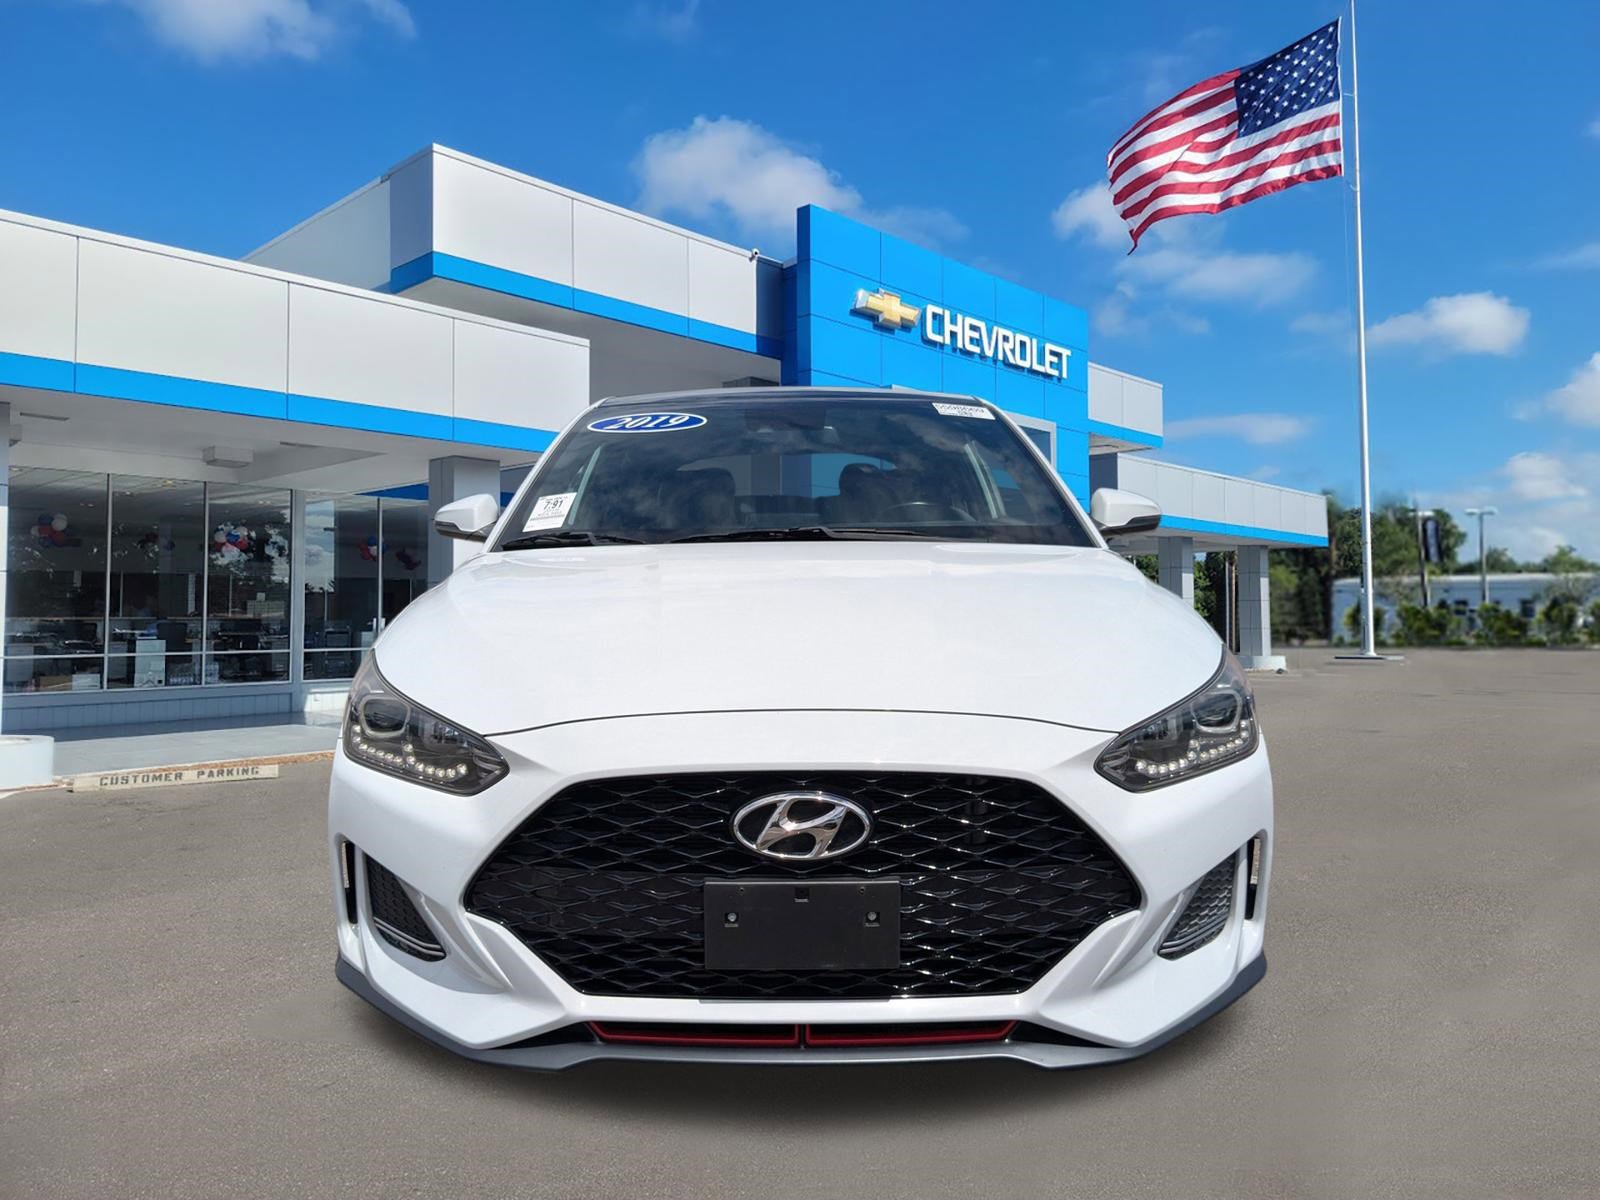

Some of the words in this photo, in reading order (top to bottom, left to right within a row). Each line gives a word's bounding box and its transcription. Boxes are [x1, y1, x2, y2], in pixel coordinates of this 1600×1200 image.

[926, 304, 1071, 379] CHEVROLET
[603, 415, 690, 430] 2019
[100, 772, 183, 786] CUSTOMER
[197, 767, 259, 779] PARKING
